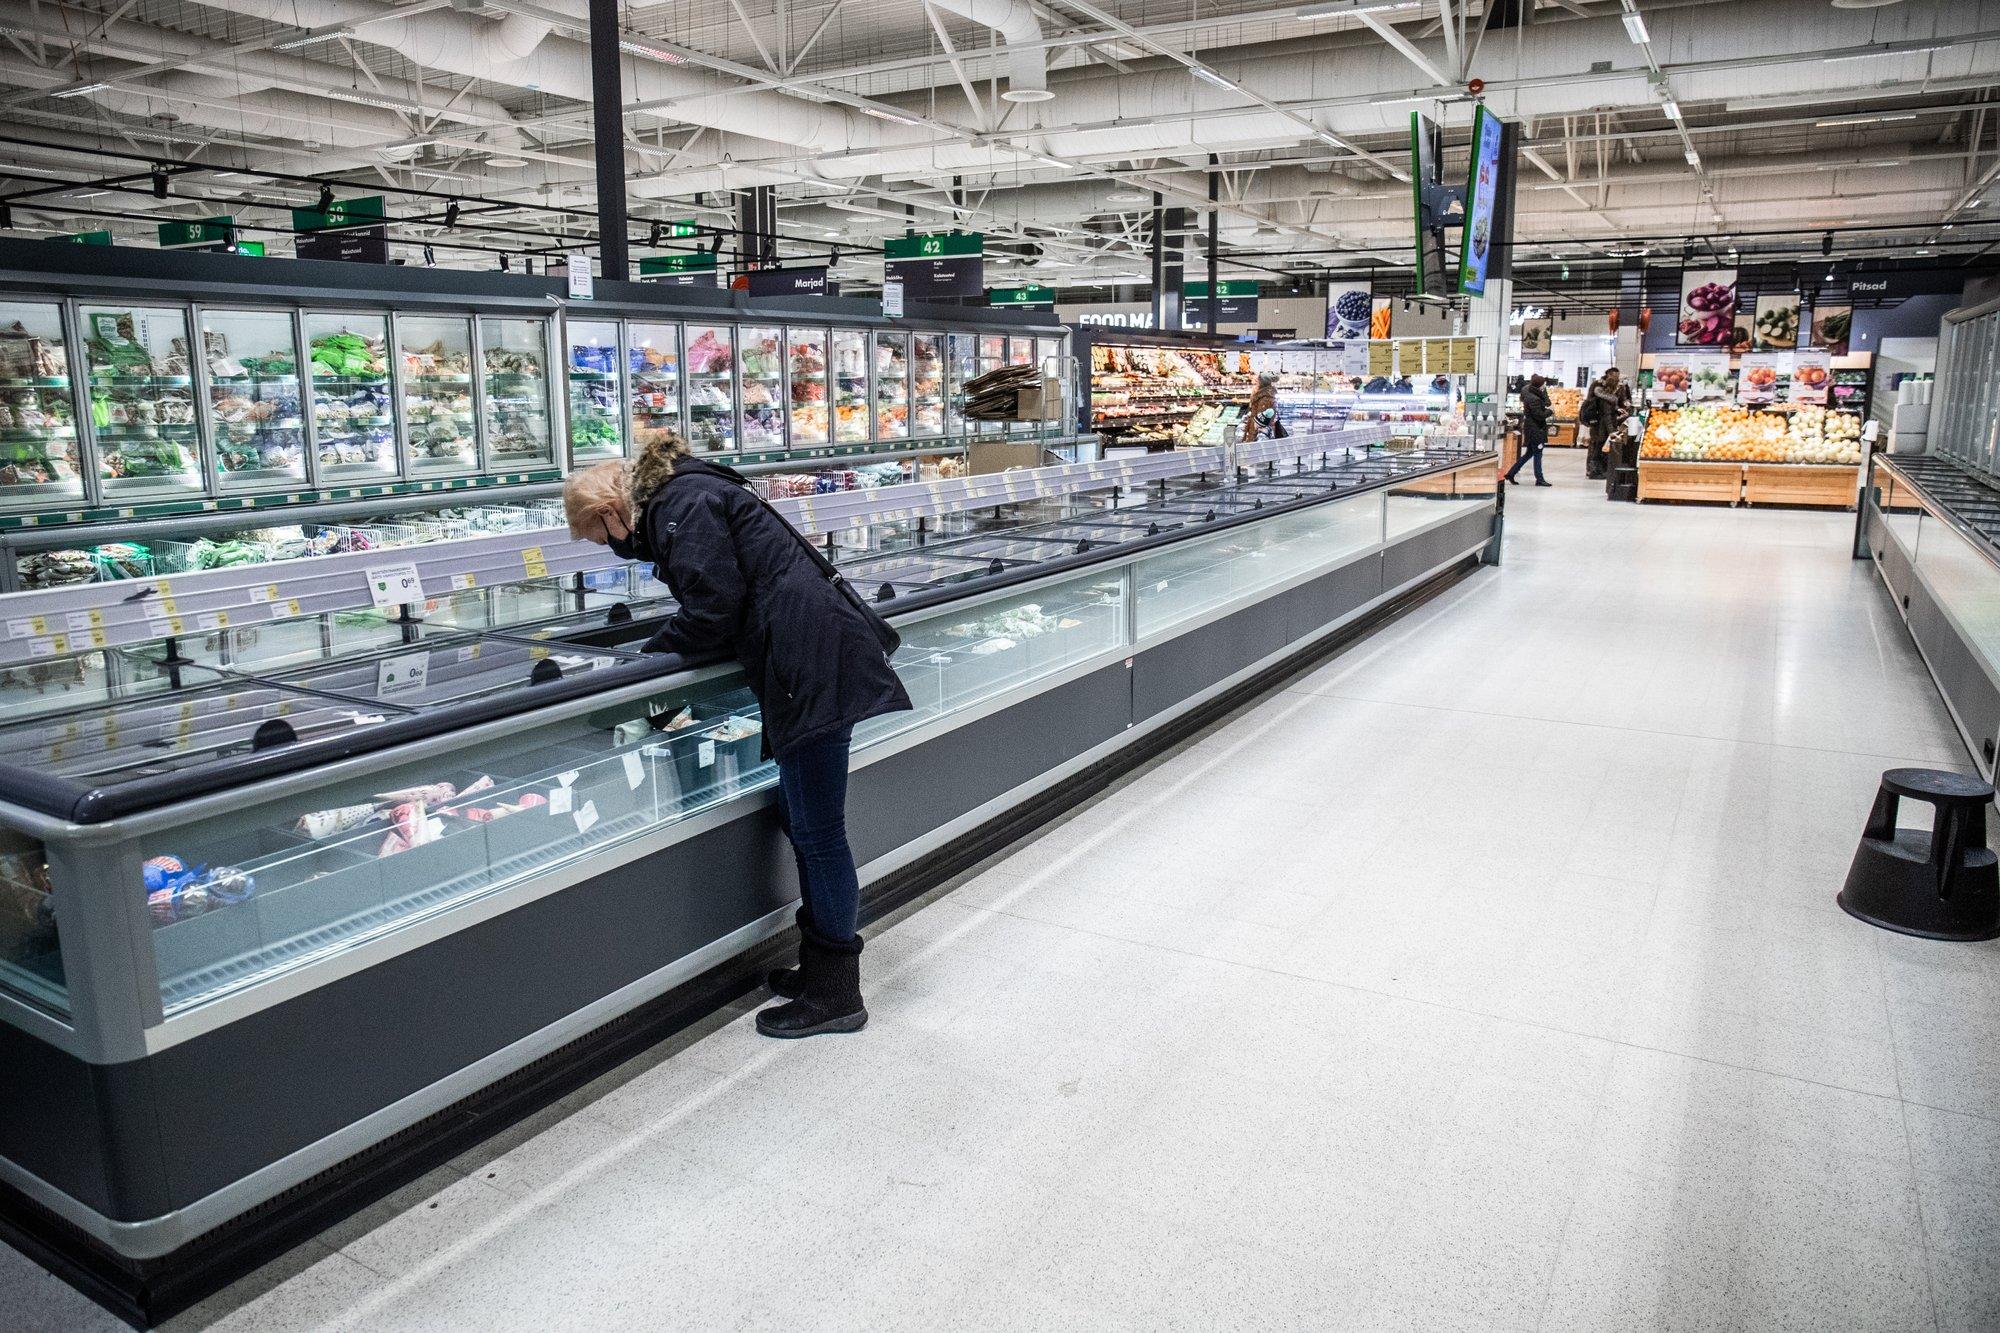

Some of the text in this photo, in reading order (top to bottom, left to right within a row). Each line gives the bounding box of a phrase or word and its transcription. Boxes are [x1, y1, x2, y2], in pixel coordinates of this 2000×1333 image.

[188, 224, 202, 239] 59
[923, 241, 940, 254] 42
[671, 258, 683, 270] 43
[794, 277, 824, 290] Marjad
[1852, 280, 1887, 291] Pitsad
[1015, 292, 1027, 301] 43
